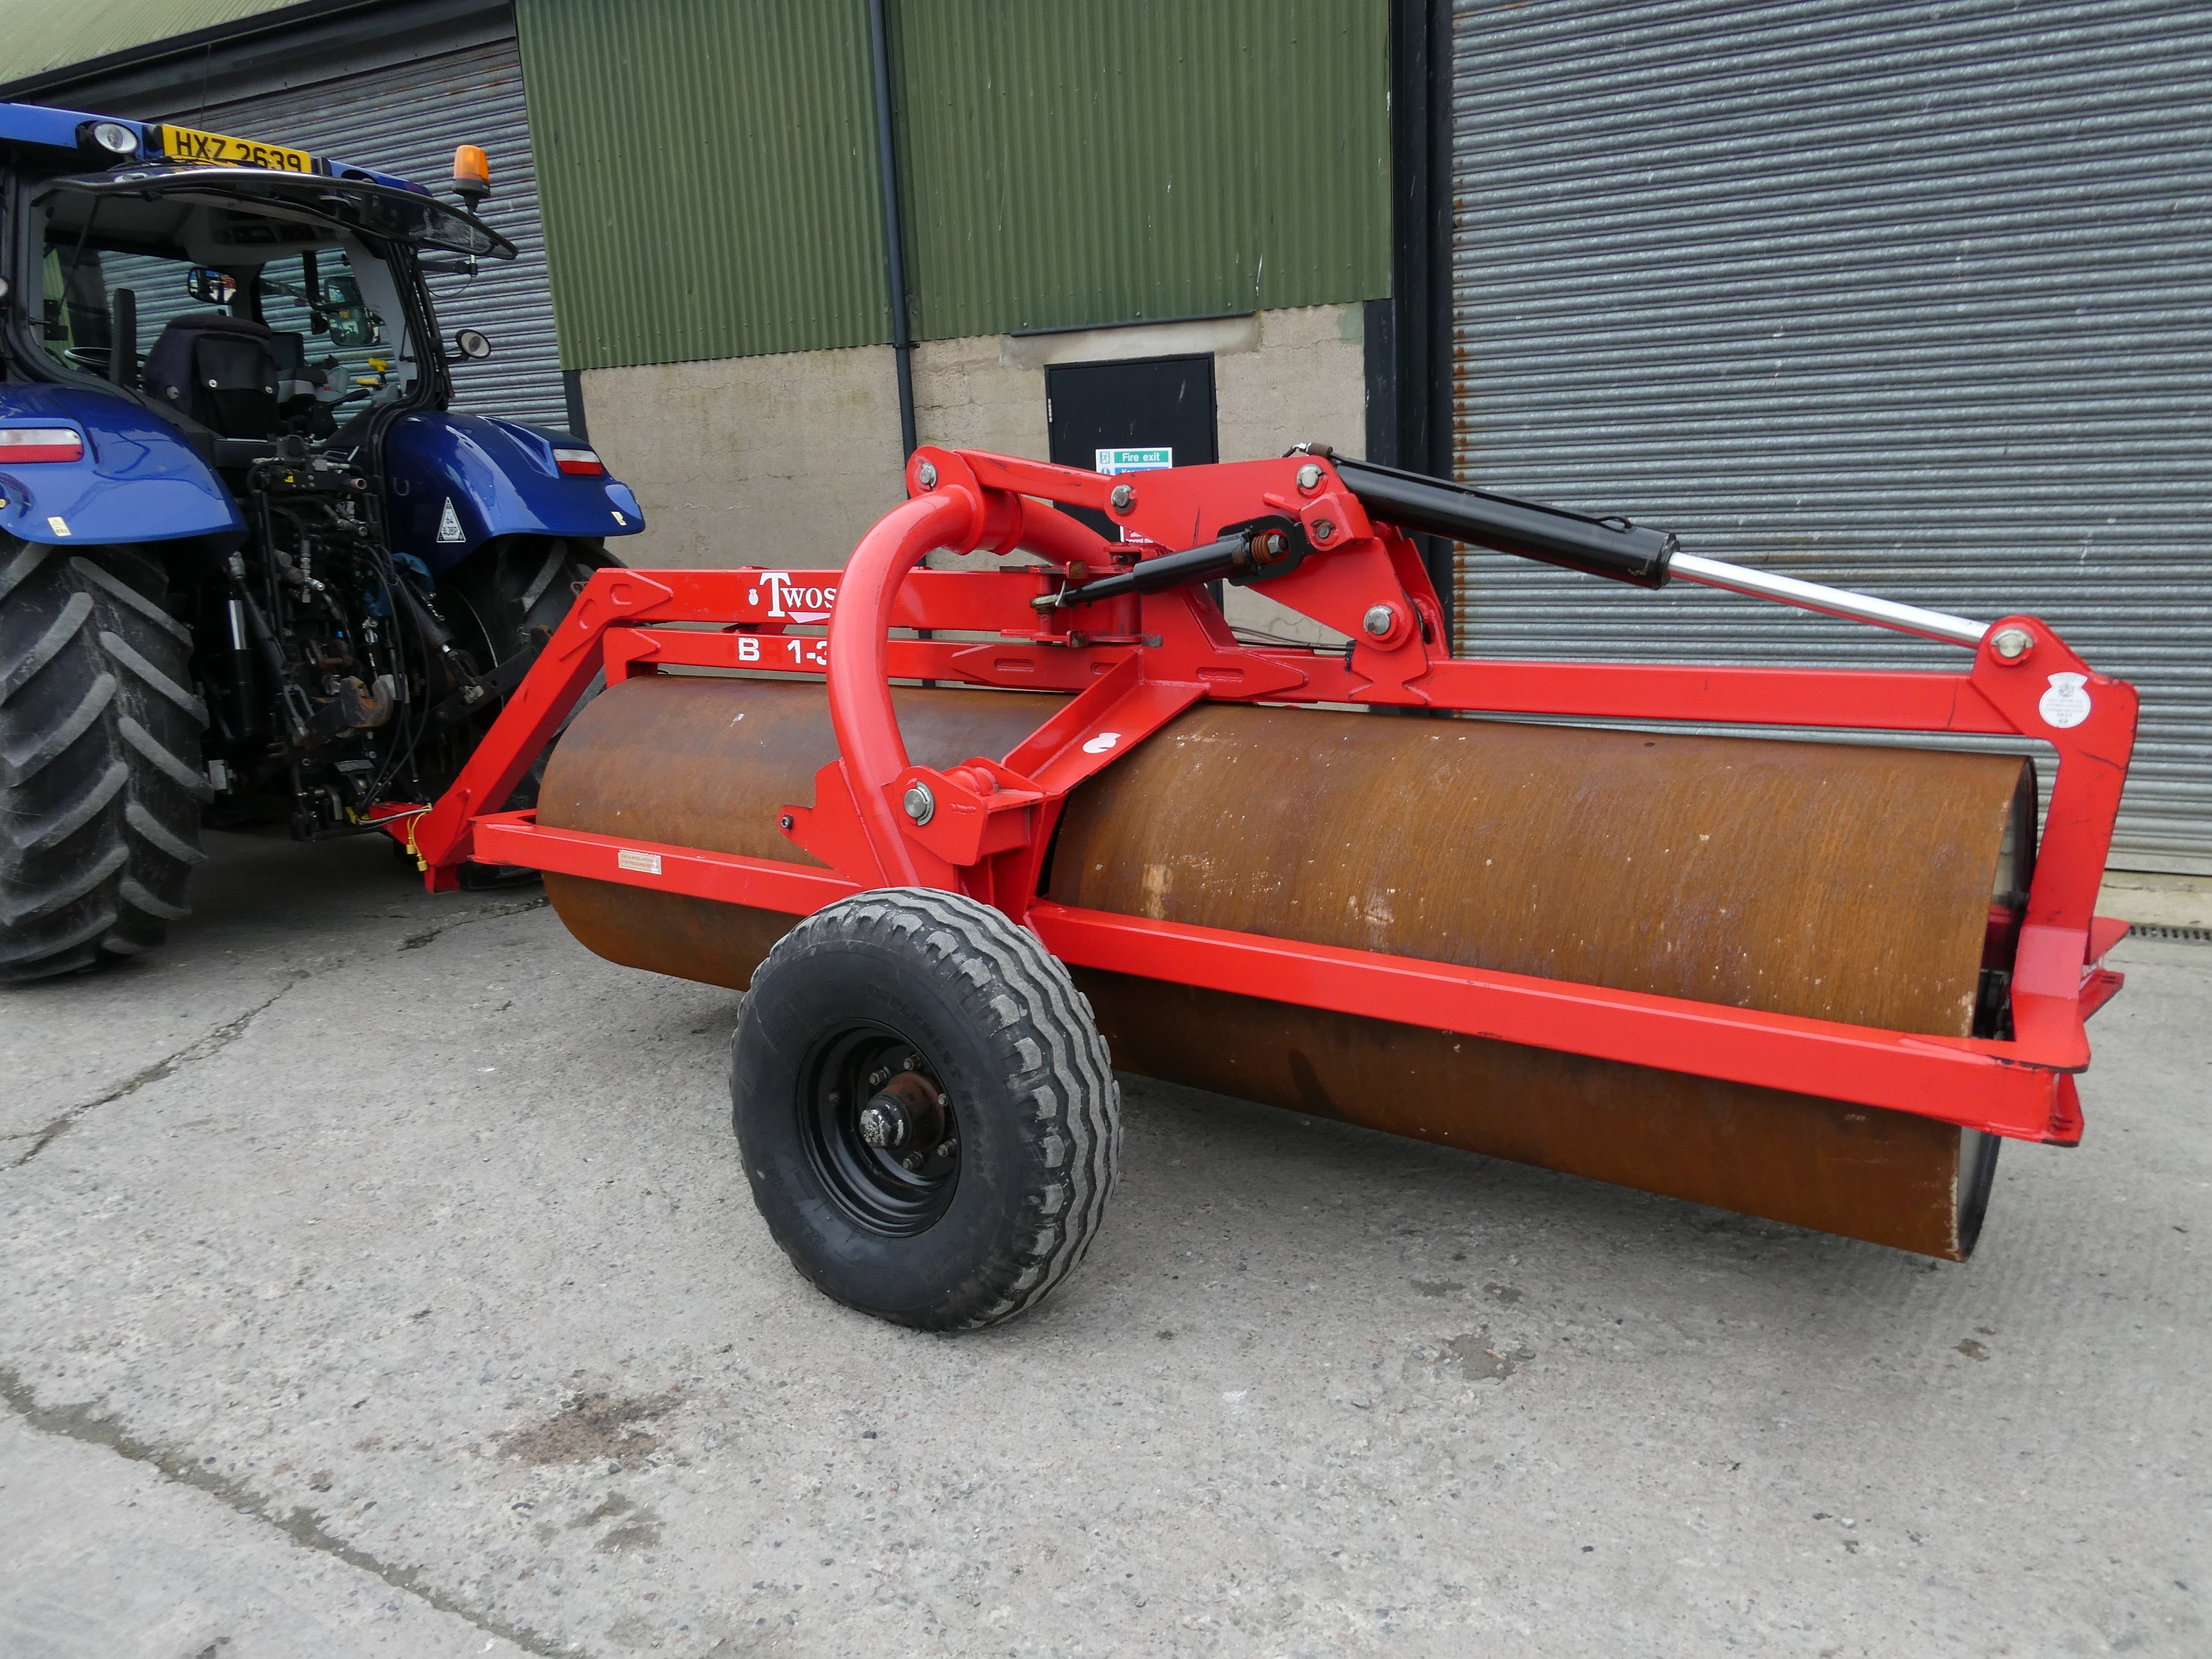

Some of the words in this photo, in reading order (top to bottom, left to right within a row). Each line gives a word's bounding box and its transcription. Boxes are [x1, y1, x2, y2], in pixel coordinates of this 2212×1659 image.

[175, 131, 227, 163] HXZ
[236, 143, 302, 172] 2639
[1122, 453, 1139, 462] Fire
[1143, 452, 1160, 461] exit
